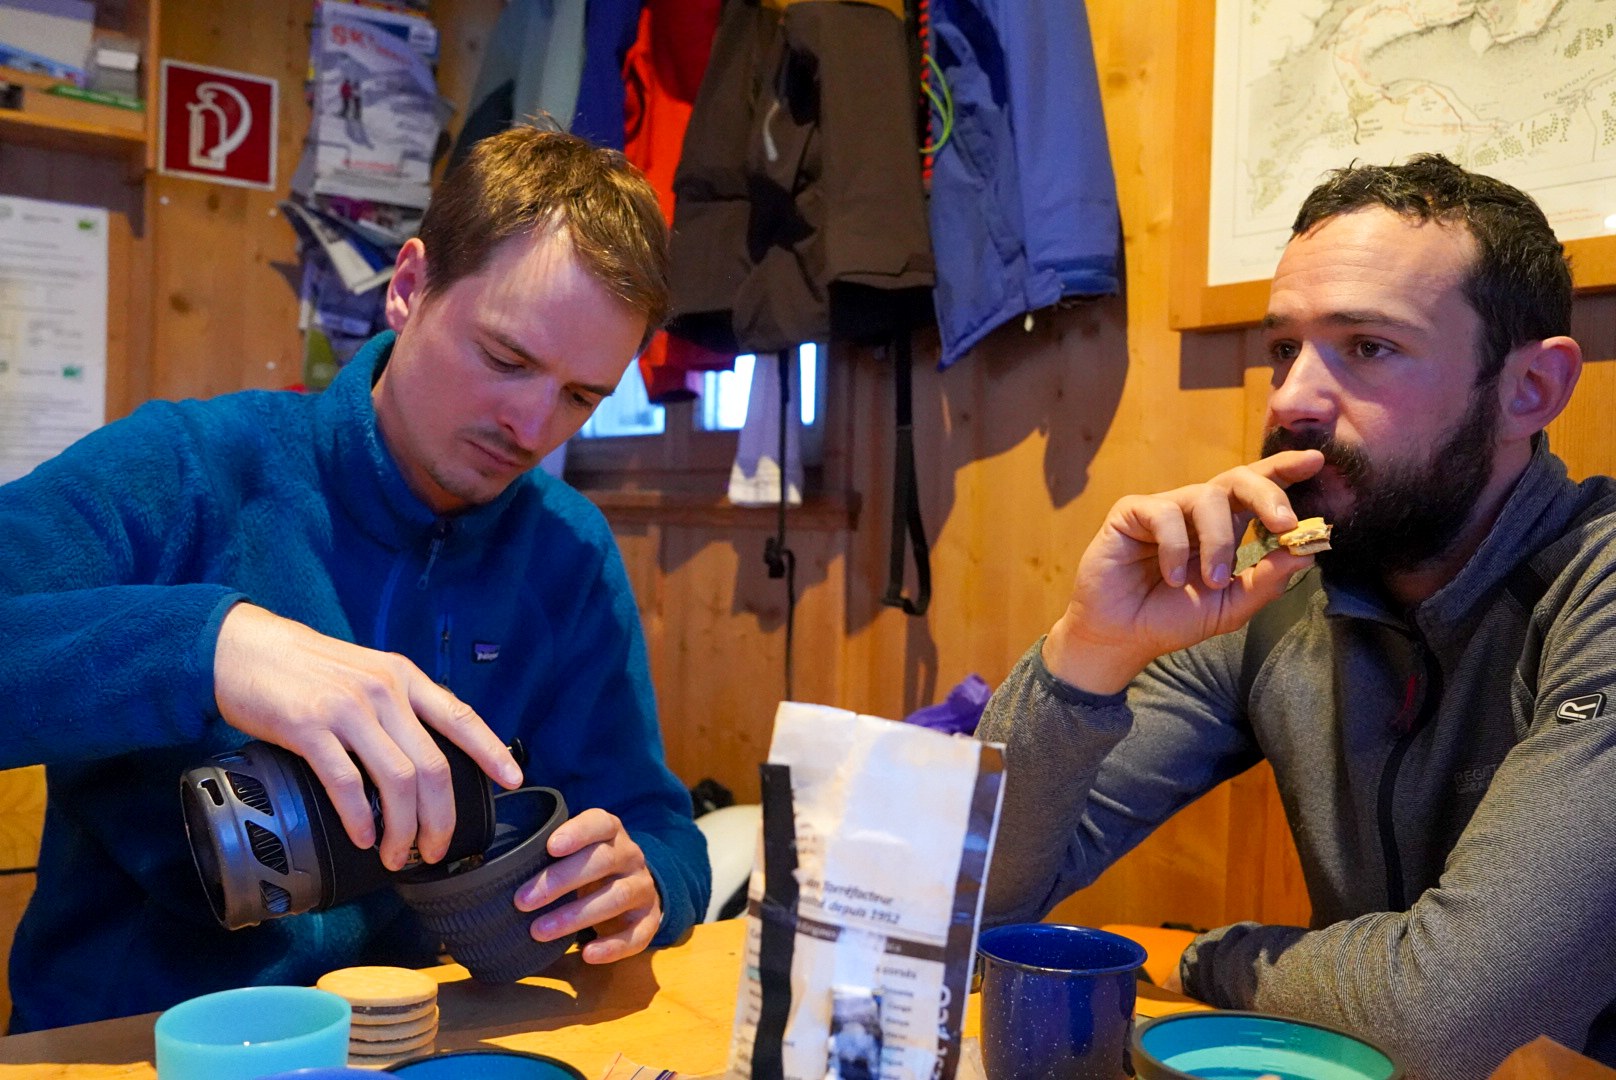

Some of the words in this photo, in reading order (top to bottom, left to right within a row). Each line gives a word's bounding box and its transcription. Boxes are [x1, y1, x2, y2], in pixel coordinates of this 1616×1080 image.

[1560, 701, 1597, 720] R
[828, 900, 867, 918] depuis
[871, 908, 902, 925] 1952
